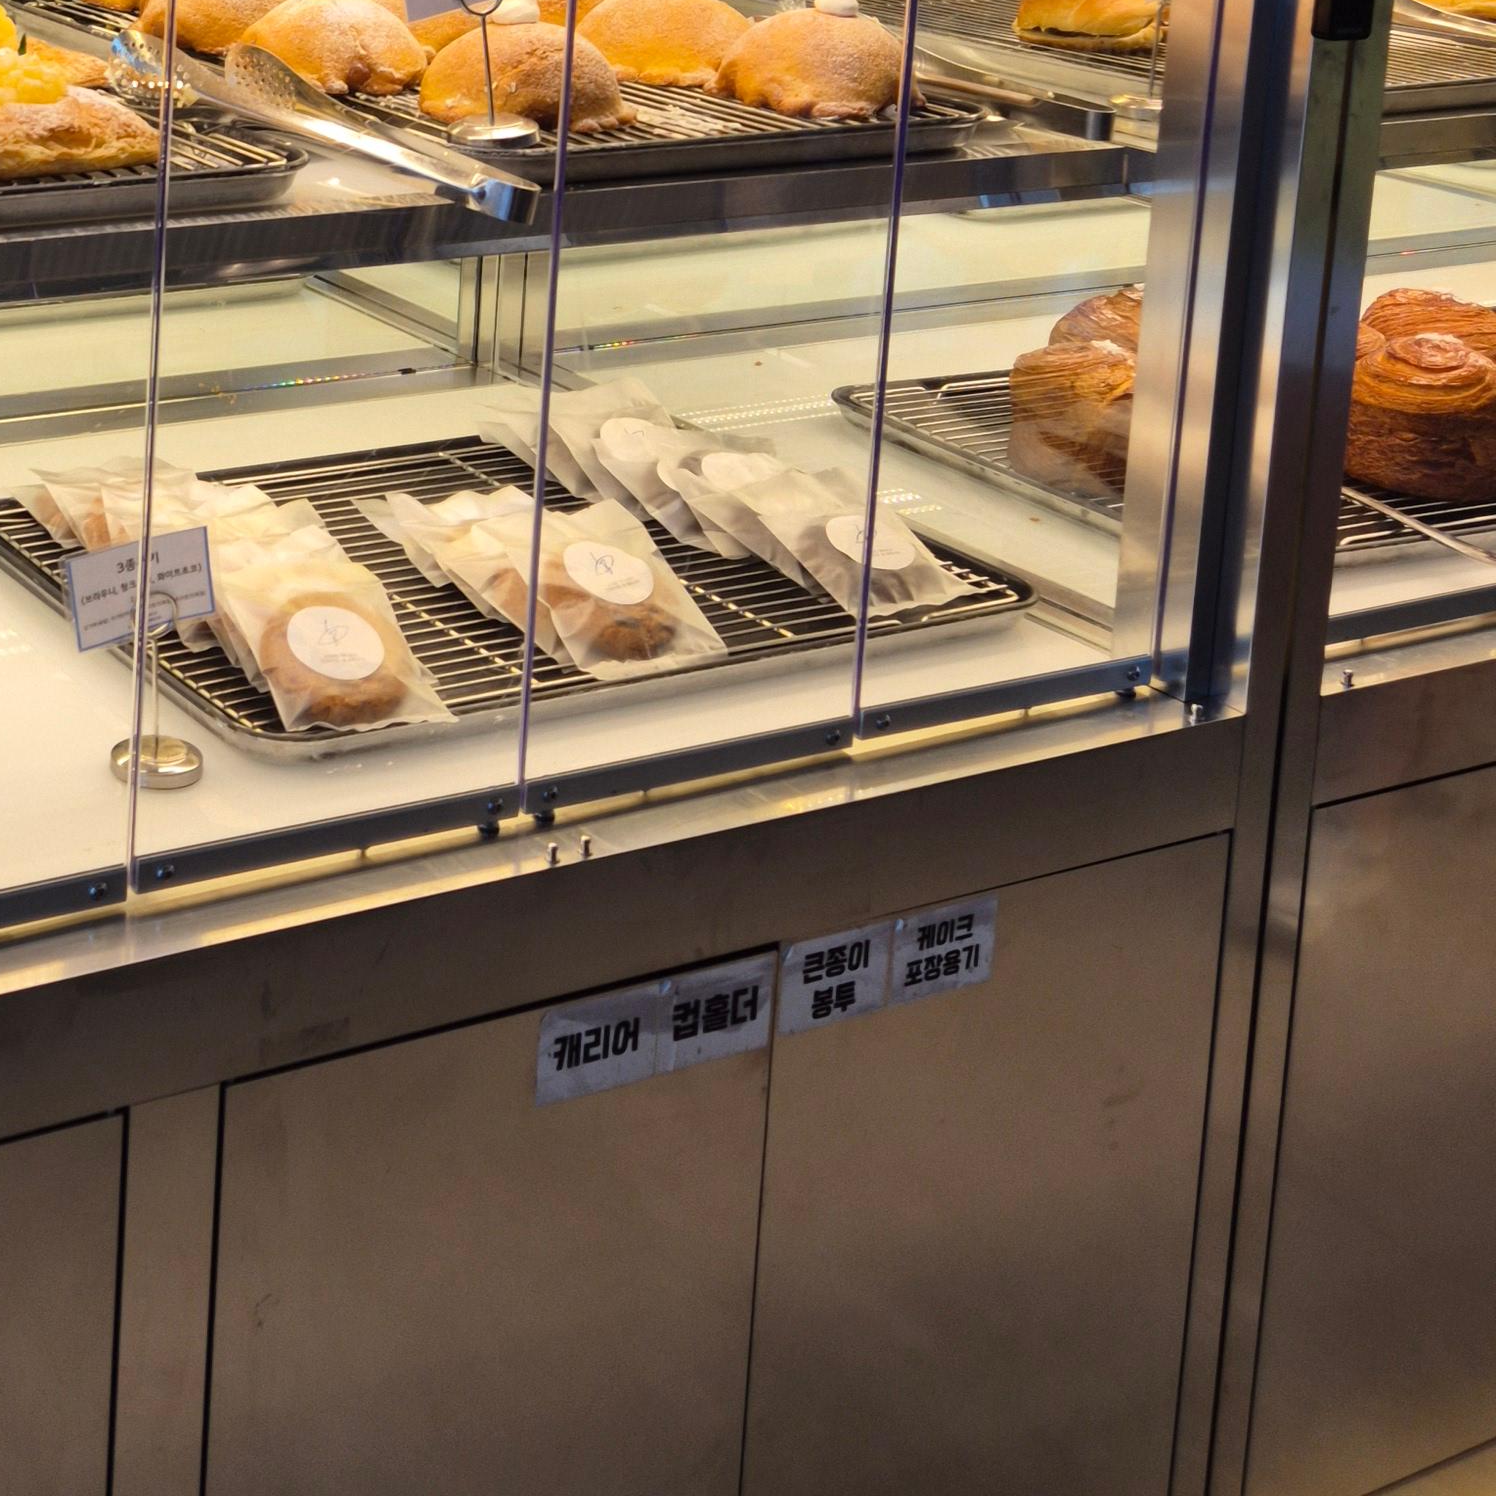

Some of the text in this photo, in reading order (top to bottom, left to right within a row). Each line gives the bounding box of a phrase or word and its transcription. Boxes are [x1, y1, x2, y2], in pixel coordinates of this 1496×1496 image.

[916, 913, 976, 952] 케이크
[802, 939, 871, 985] 큰종이
[902, 943, 980, 988] 포장용기
[672, 985, 760, 1042] 컵홀더
[810, 980, 856, 1020] 봉투
[552, 1017, 640, 1072] 캐리어
